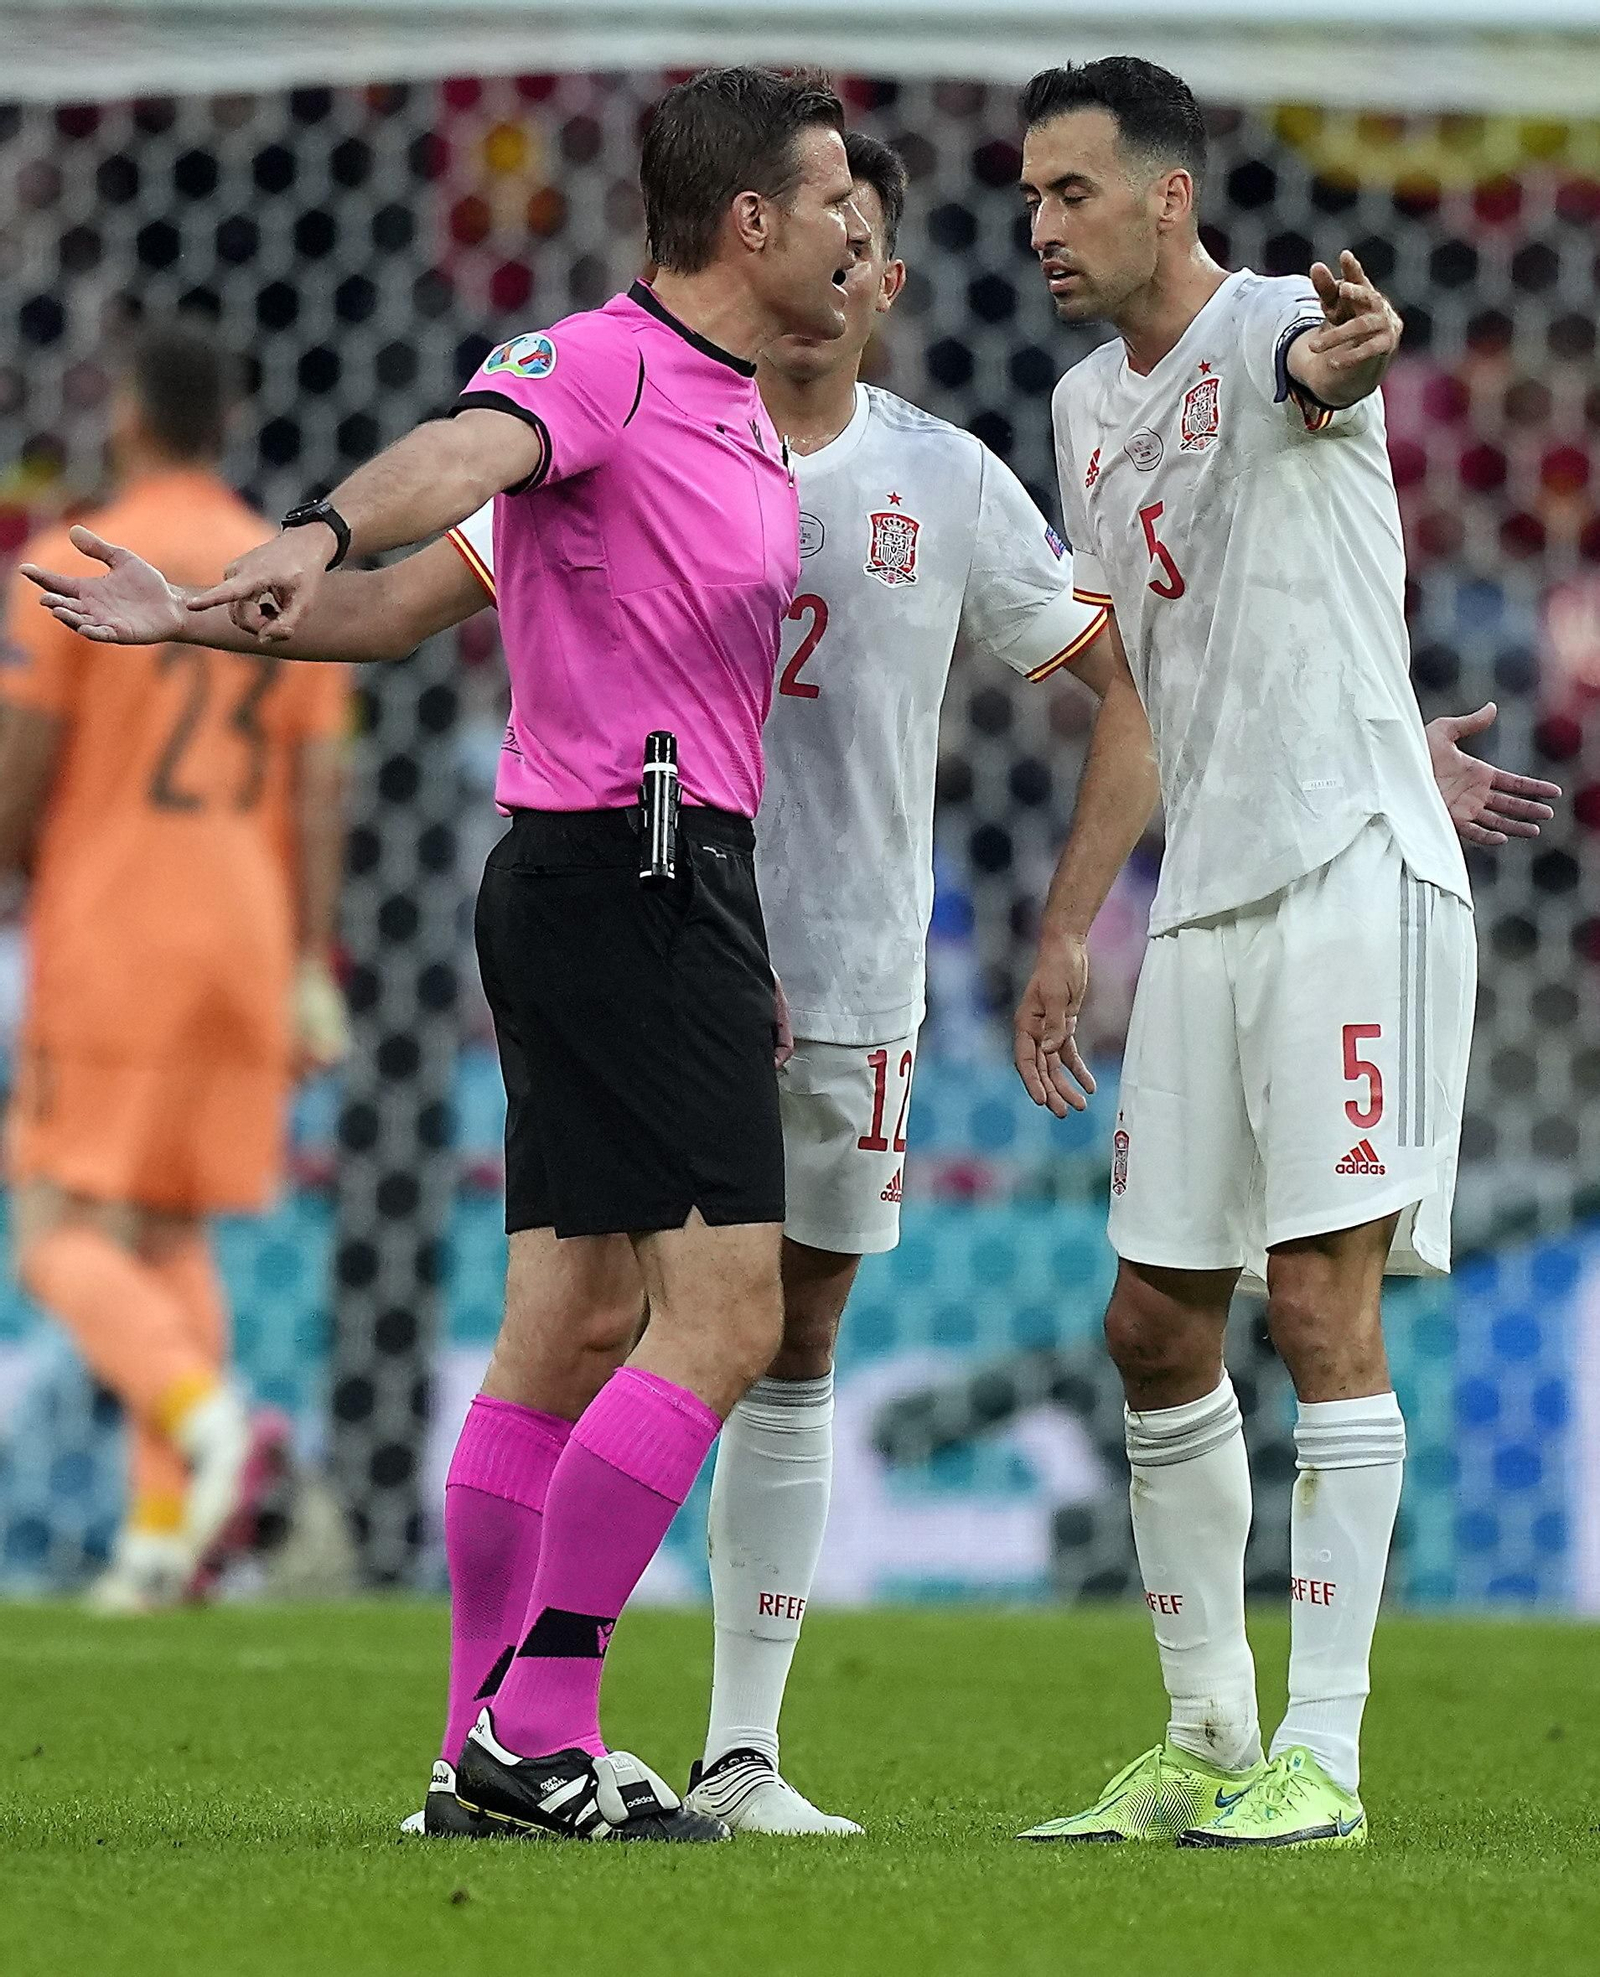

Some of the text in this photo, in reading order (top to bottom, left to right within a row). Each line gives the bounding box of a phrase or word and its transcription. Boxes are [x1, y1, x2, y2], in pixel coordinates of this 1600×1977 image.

[1138, 500, 1185, 599] 5
[148, 641, 281, 812] 23
[858, 1050, 912, 1152] 12
[1343, 1024, 1383, 1129] 5
[1335, 1161, 1386, 1175] adidas
[759, 1592, 806, 1620] RFEF
[1290, 1577, 1336, 1606] RFEF
